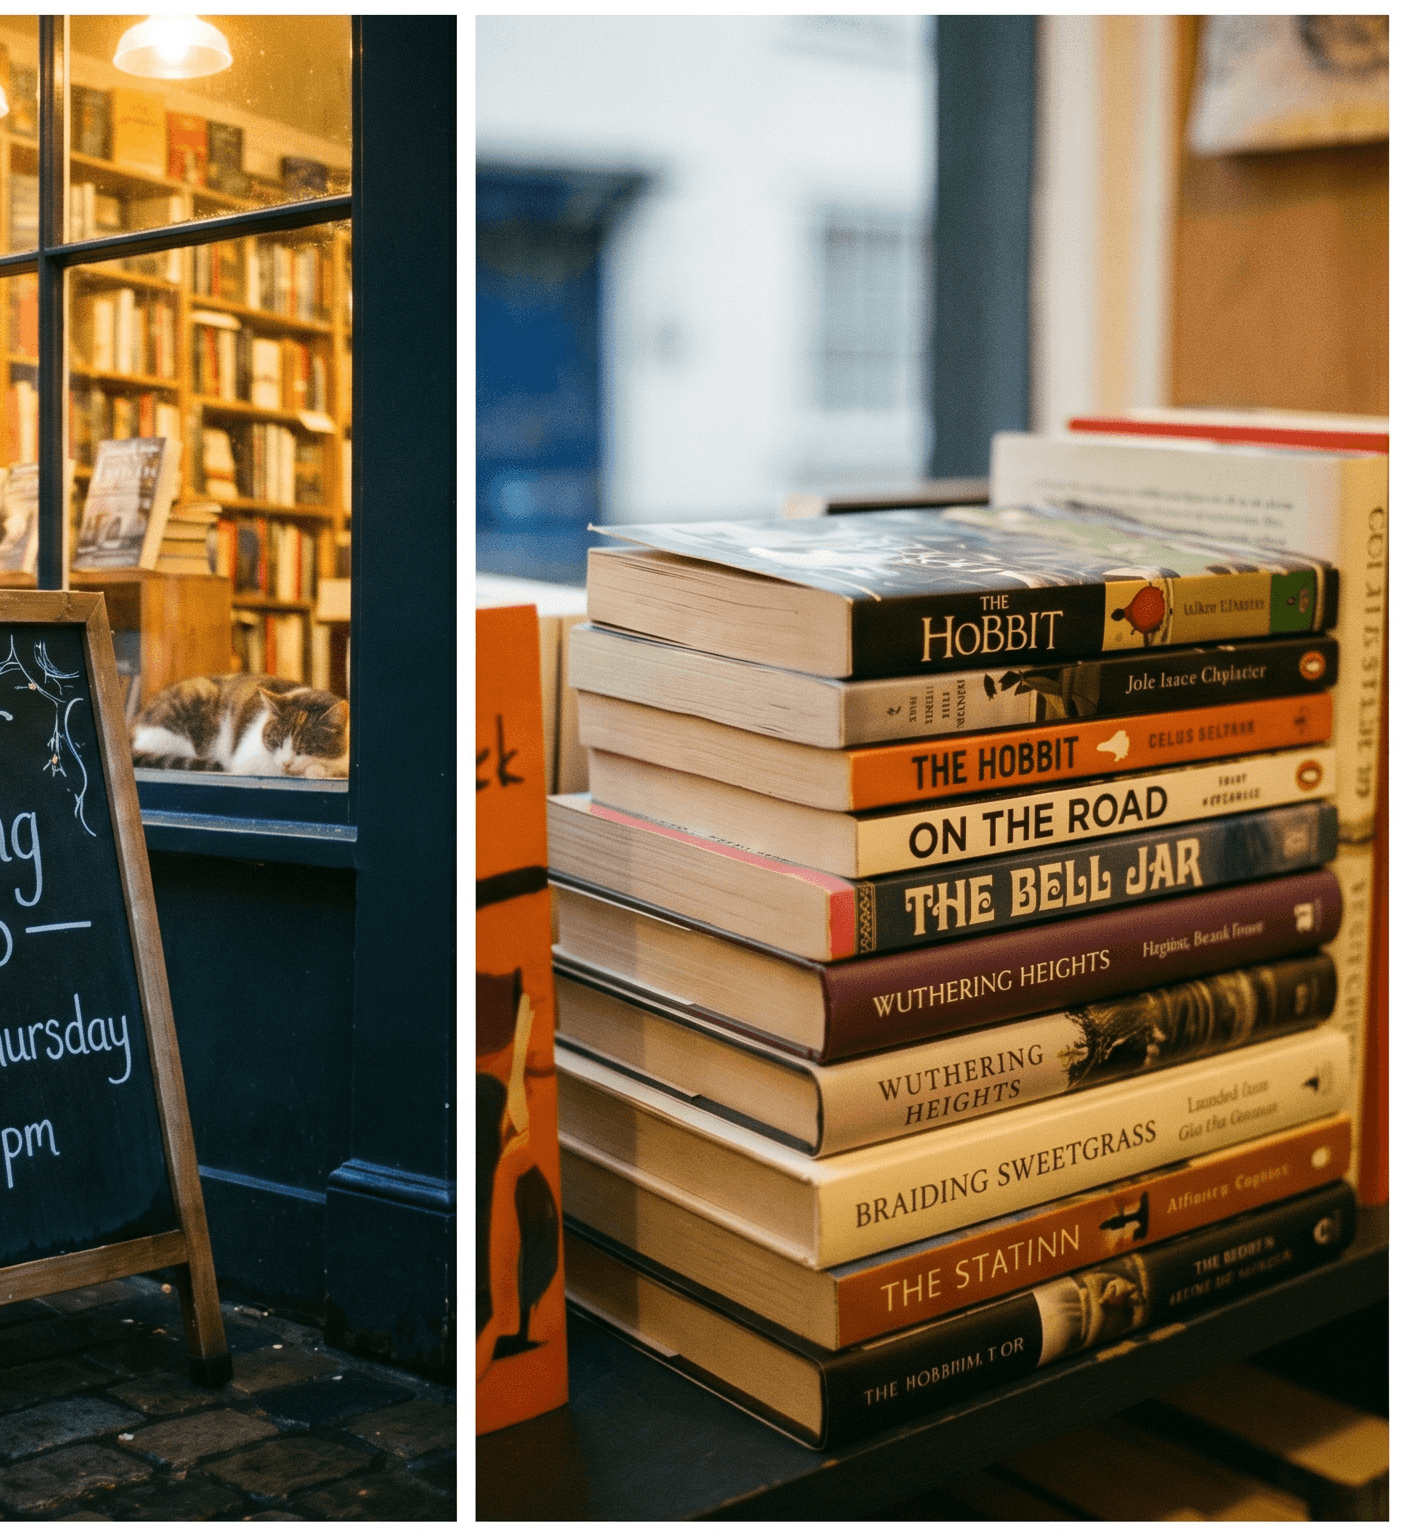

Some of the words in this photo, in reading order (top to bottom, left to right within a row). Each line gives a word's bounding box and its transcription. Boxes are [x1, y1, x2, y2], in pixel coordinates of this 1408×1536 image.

[979, 594, 1010, 611] THE
[911, 750, 968, 791] THE
[978, 735, 1080, 782] HOBBIT
[908, 815, 967, 859] ON
[982, 802, 1055, 847] THE
[1068, 785, 1168, 834] ROAD
[904, 874, 996, 937] THE
[1009, 855, 1112, 918] BELL
[1125, 837, 1204, 896] JAR
[872, 969, 1013, 1018] WUTHERING
[1020, 949, 1111, 987] HEIGHTS
[877, 1044, 1044, 1101] WUTHERING
[904, 1078, 1021, 1126] HEIGHTS
[854, 1168, 990, 1228] BRAIDING
[997, 1119, 1157, 1188] SWEETGRASS
[880, 1268, 941, 1312] THE
[955, 1224, 1079, 1290] STATINN
[864, 1381, 898, 1406] THE
